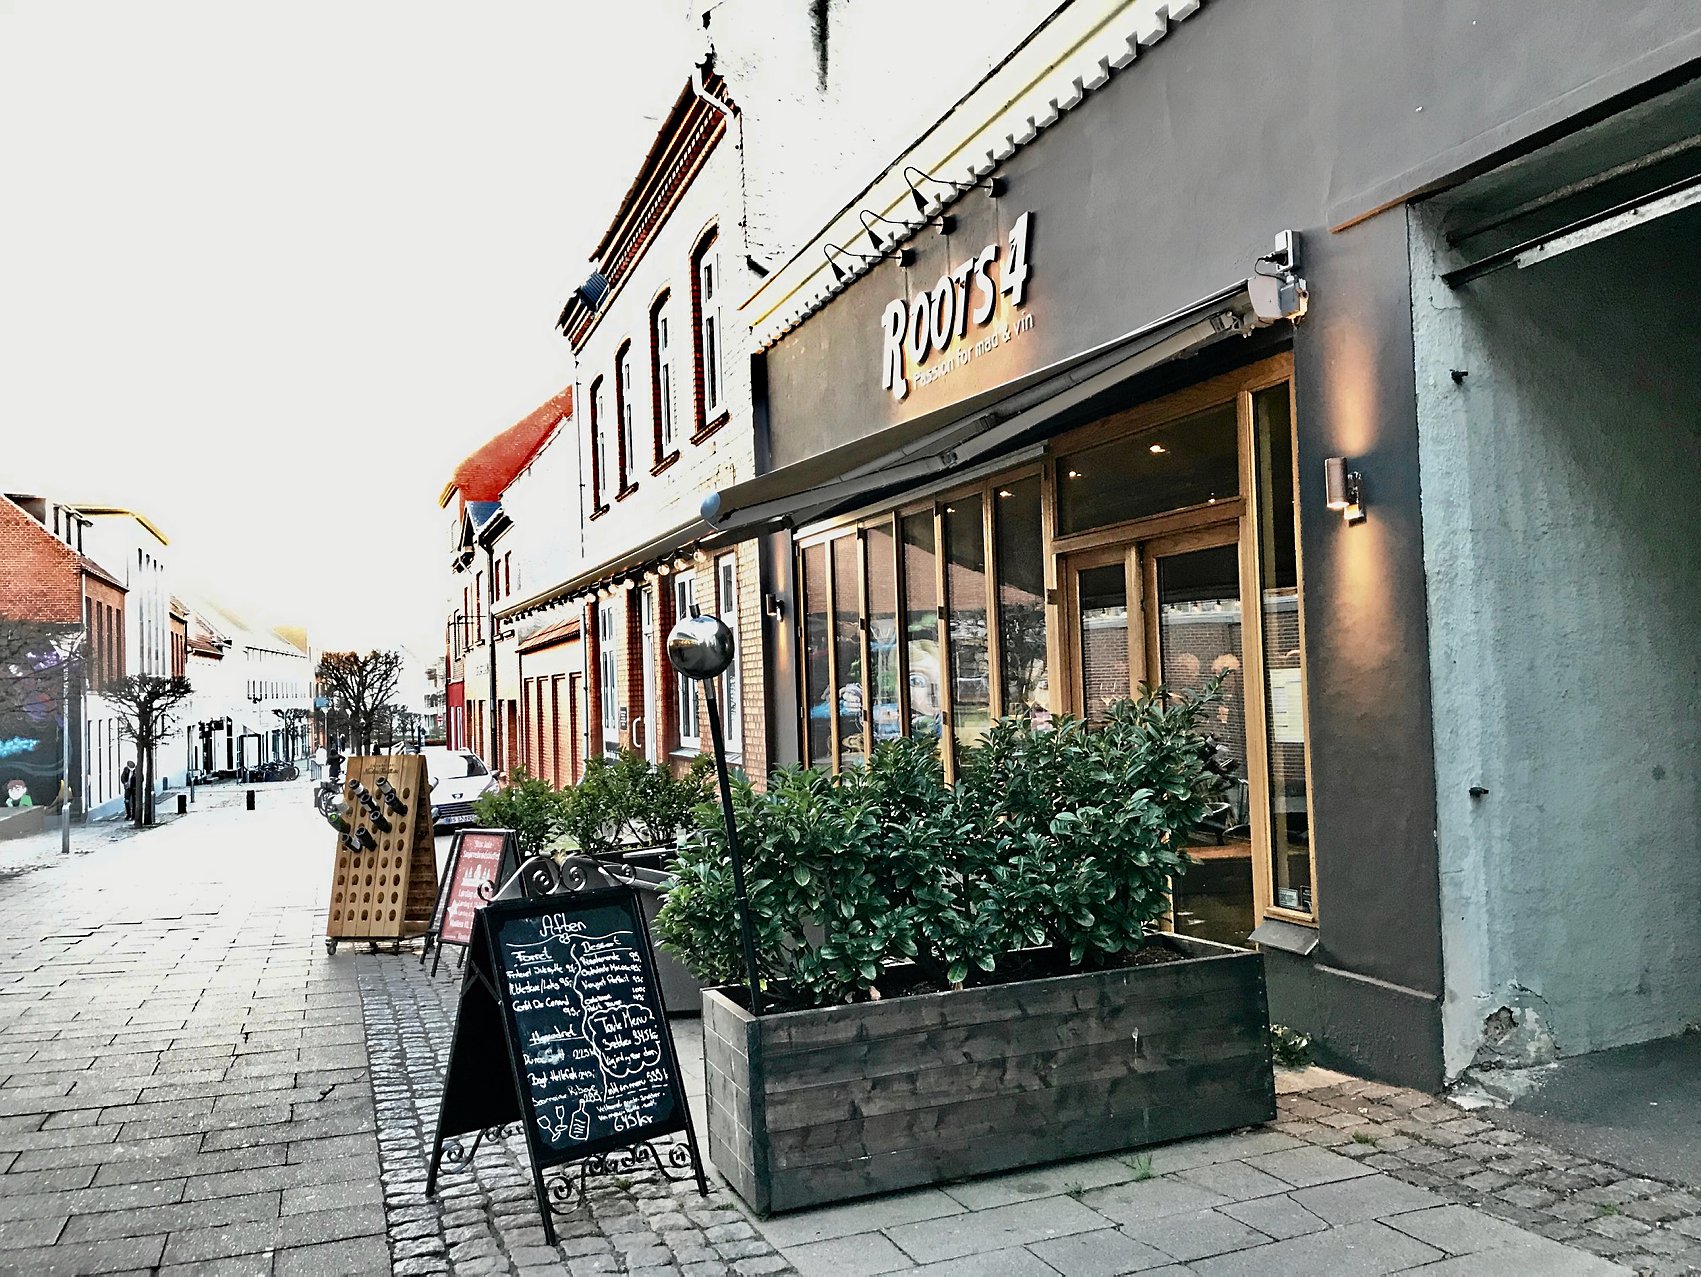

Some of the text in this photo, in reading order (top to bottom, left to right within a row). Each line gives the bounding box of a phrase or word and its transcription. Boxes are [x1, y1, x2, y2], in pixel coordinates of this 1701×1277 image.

[1000, 210, 1032, 307] 4
[912, 310, 1034, 389] Passion for mad & vin
[540, 913, 587, 937] Aften
[622, 1009, 647, 1029] Menu
